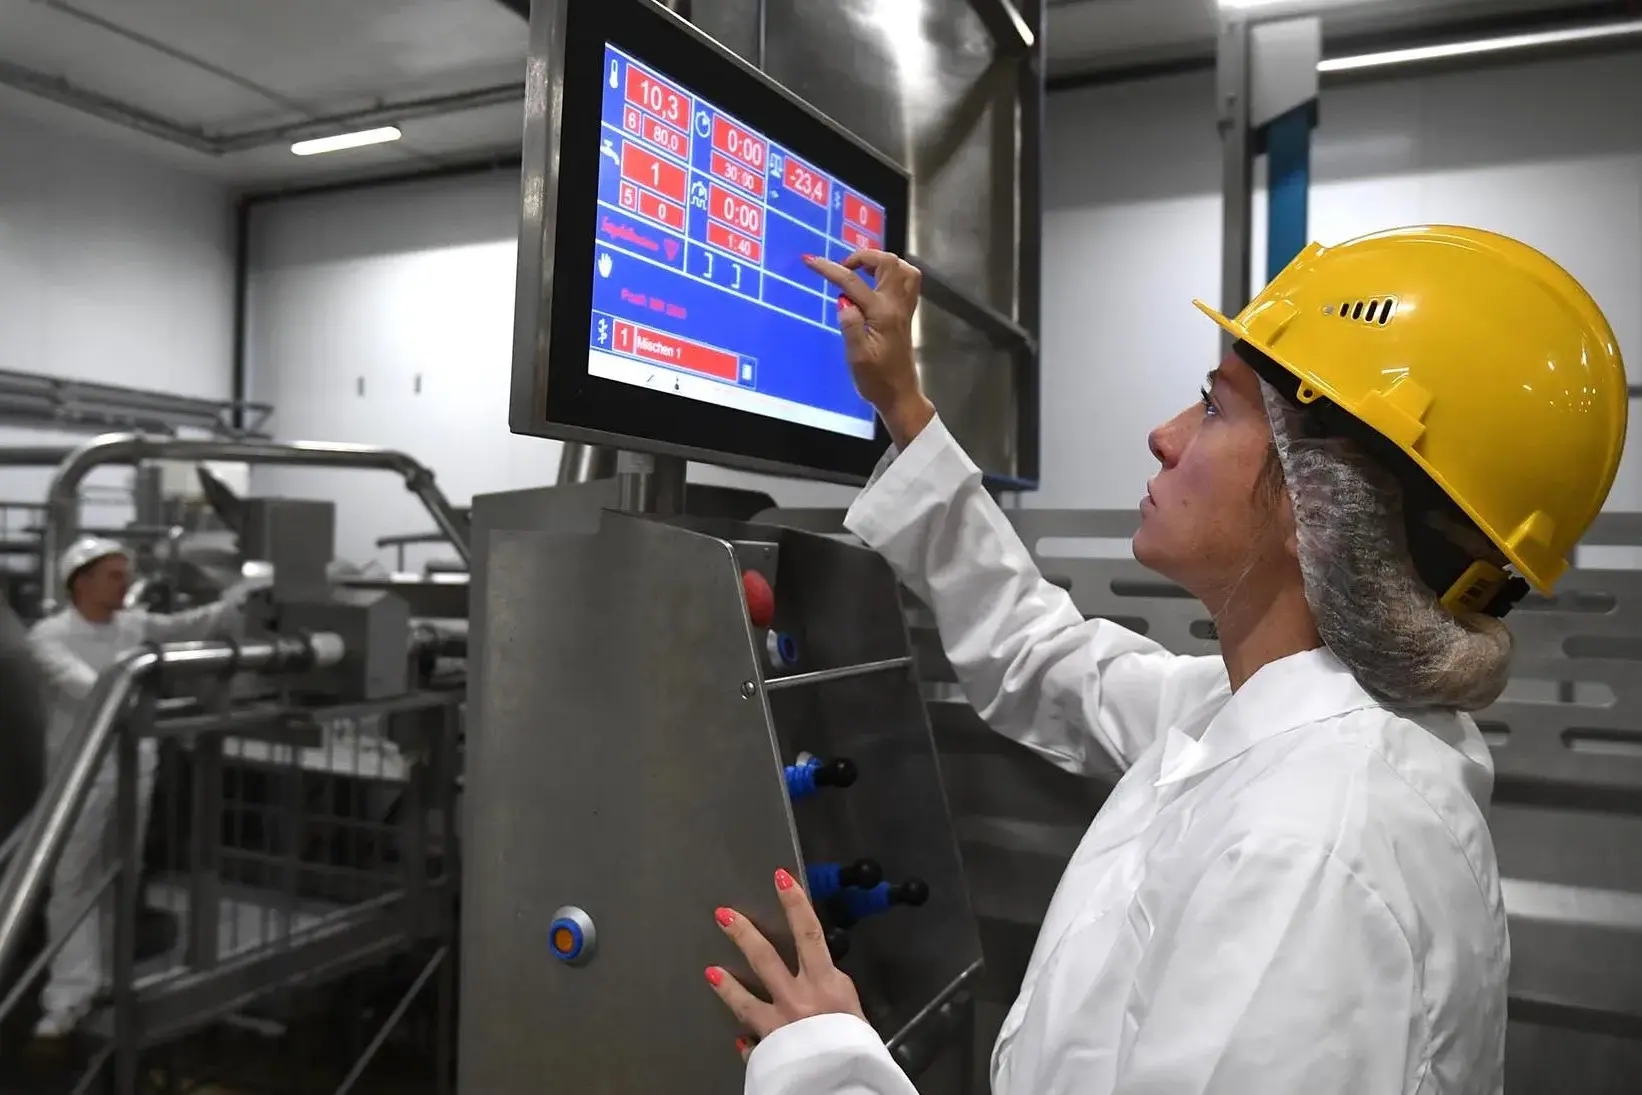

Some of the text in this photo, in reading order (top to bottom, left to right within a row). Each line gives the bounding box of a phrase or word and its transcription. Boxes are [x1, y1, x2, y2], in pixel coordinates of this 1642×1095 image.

[641, 80, 679, 120] 10,3
[628, 112, 636, 129] 6
[727, 129, 761, 166] 0:00
[651, 162, 659, 187] 1
[624, 190, 632, 205] 5
[658, 204, 666, 219] 0
[724, 197, 759, 231] 0:00
[859, 205, 868, 225] 0
[620, 328, 628, 346] 1
[637, 335, 674, 357] Mischen
